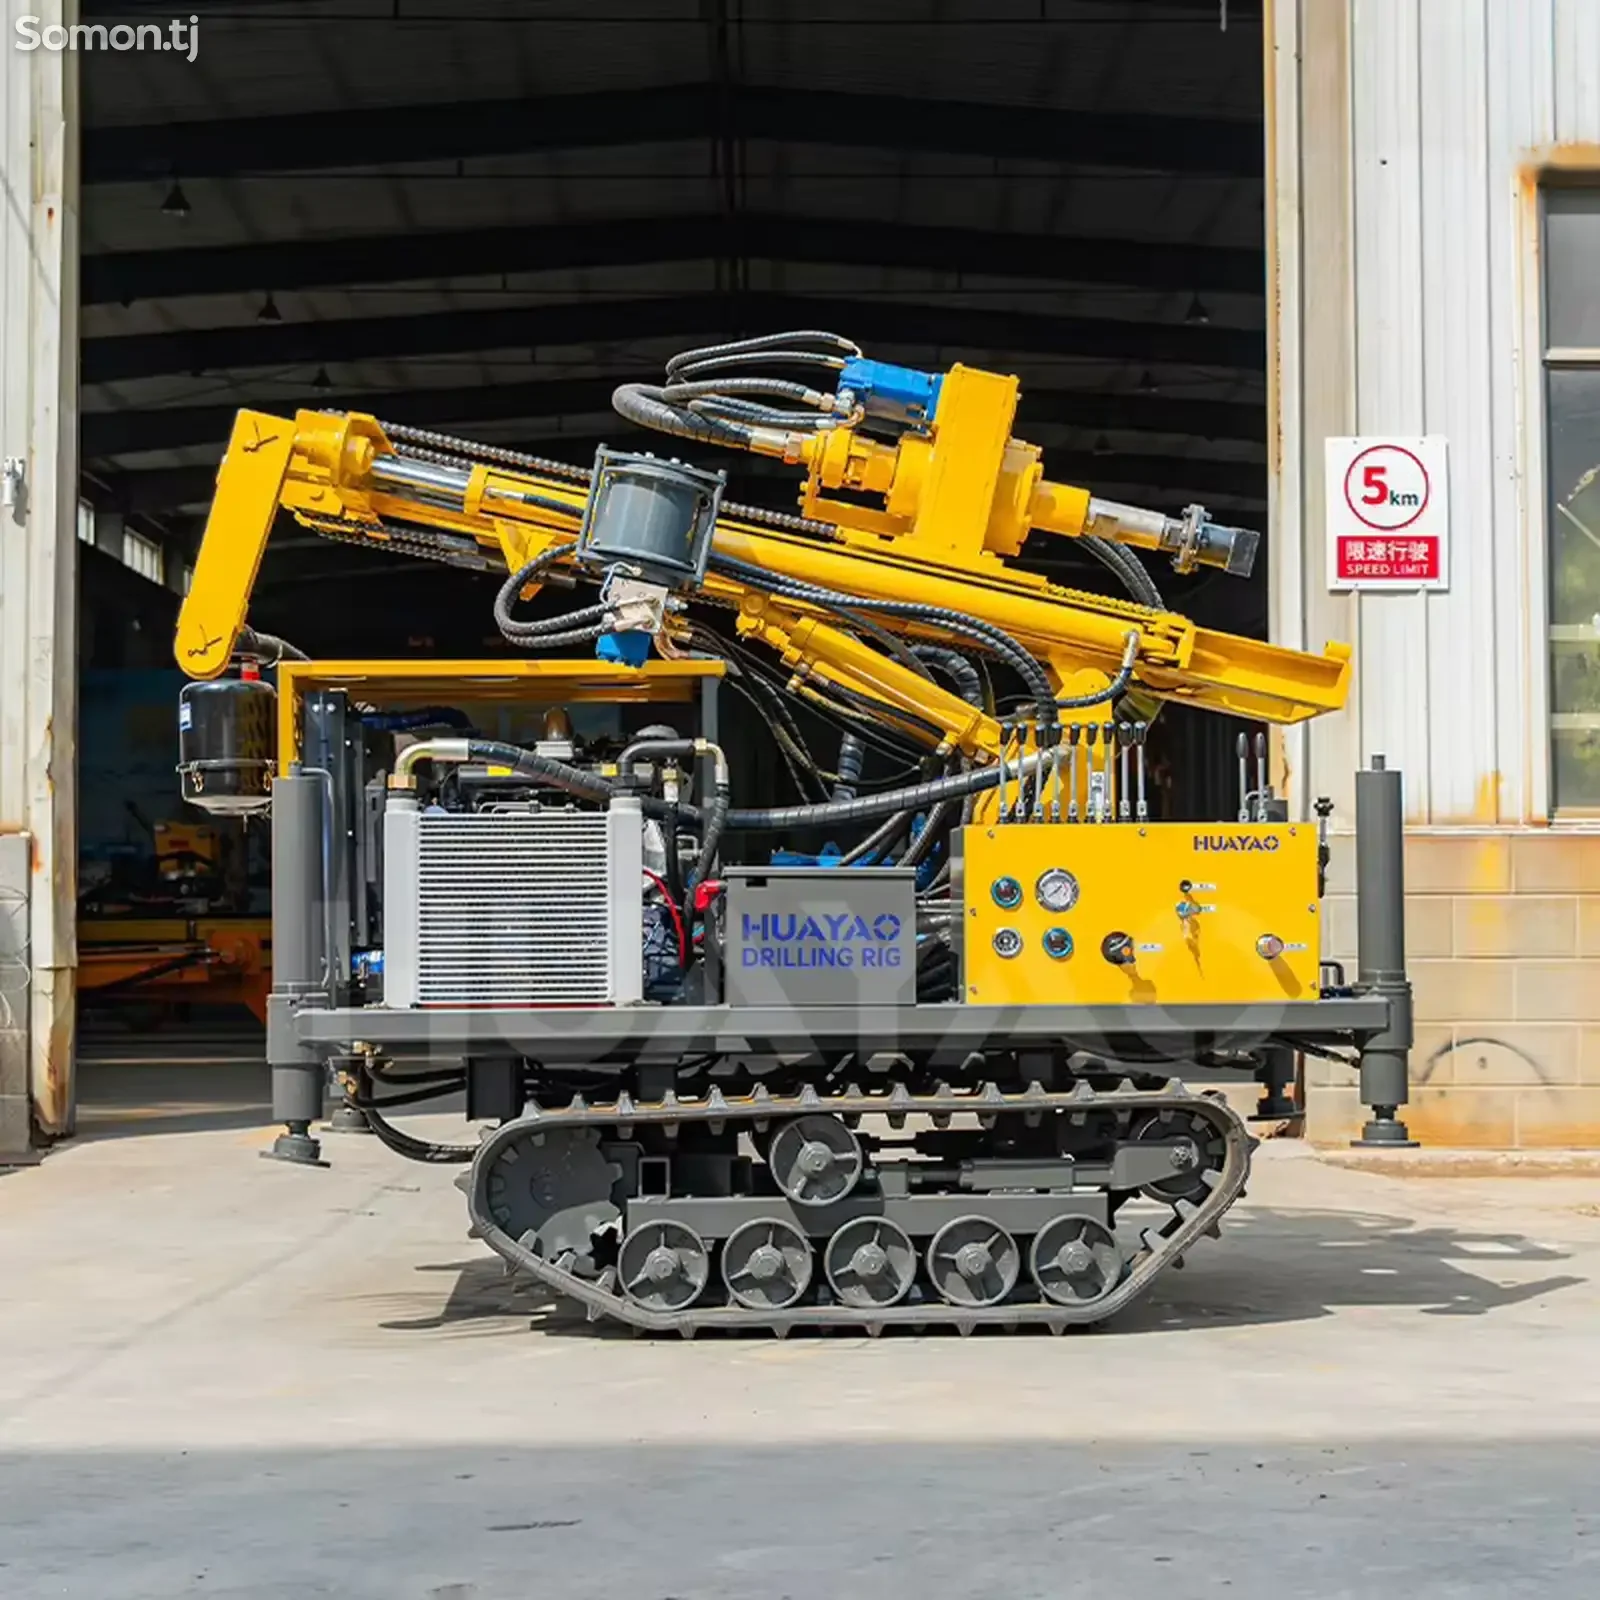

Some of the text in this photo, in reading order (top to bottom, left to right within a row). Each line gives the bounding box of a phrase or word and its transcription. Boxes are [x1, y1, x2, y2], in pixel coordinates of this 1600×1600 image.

[1345, 540, 1429, 561] 限速行驶
[1346, 563, 1429, 575] SPEED LIMIT
[1193, 835, 1279, 851] HUAYAO
[741, 914, 901, 941] HUAYAO
[741, 947, 901, 967] DRILLING RIG
